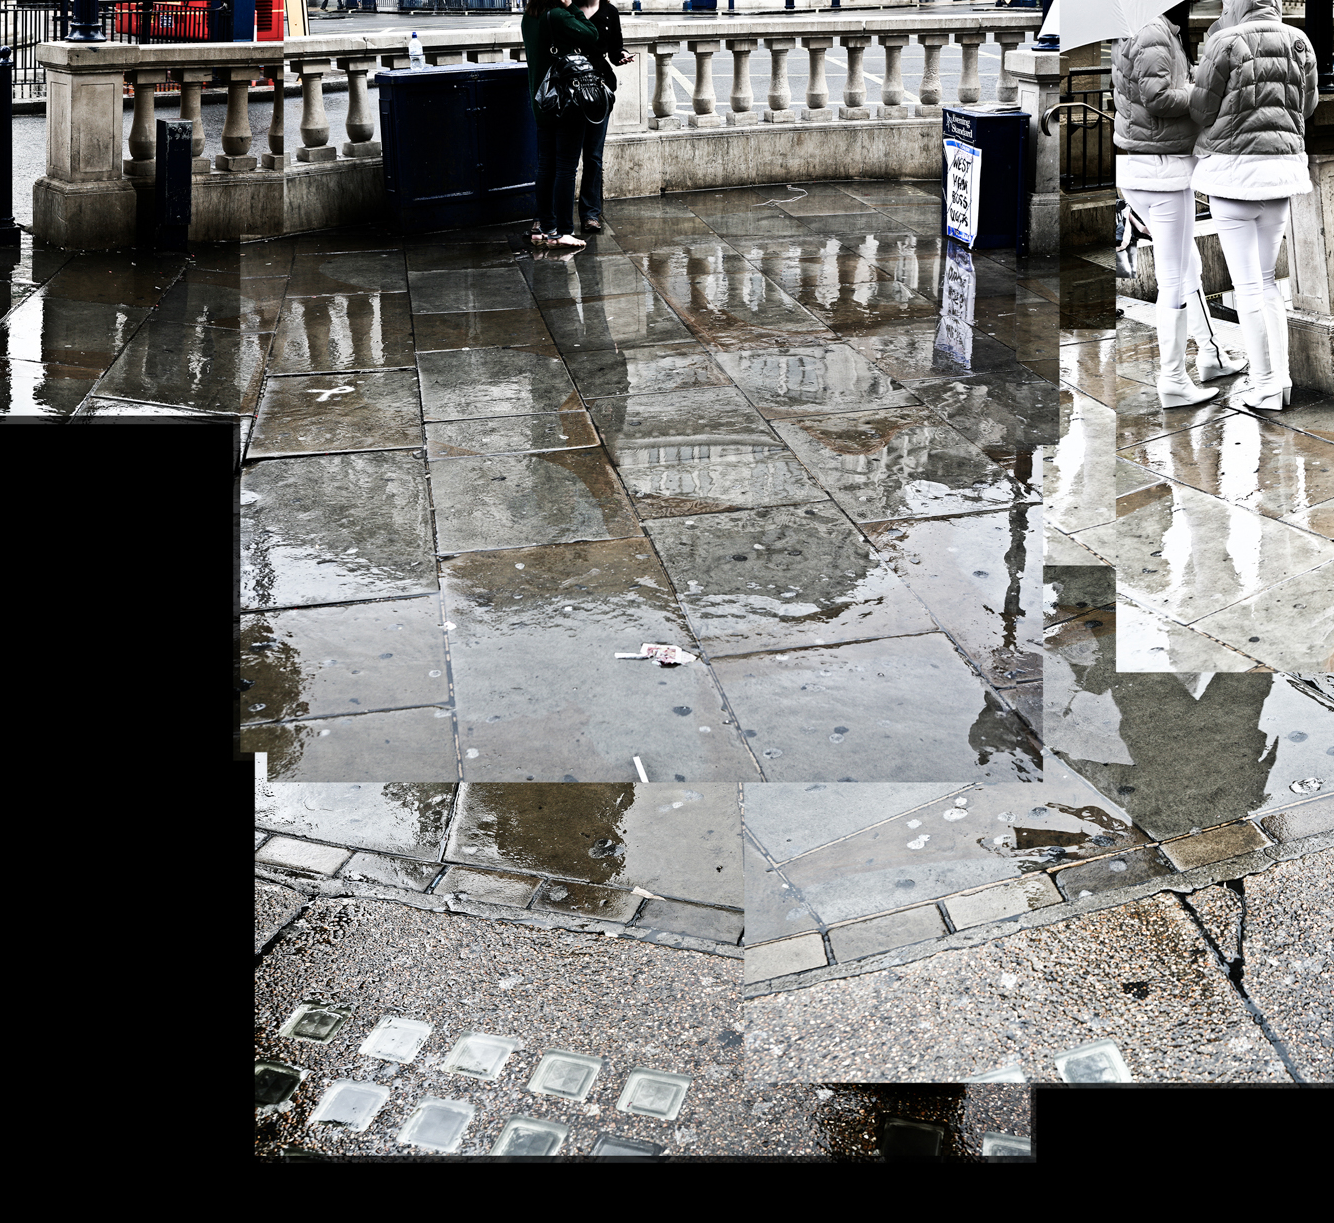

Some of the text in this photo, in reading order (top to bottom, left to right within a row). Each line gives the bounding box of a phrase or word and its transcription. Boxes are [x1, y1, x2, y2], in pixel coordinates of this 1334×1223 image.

[952, 114, 971, 129] Evening
[951, 123, 973, 138] Standard
[953, 156, 971, 173] WEST
